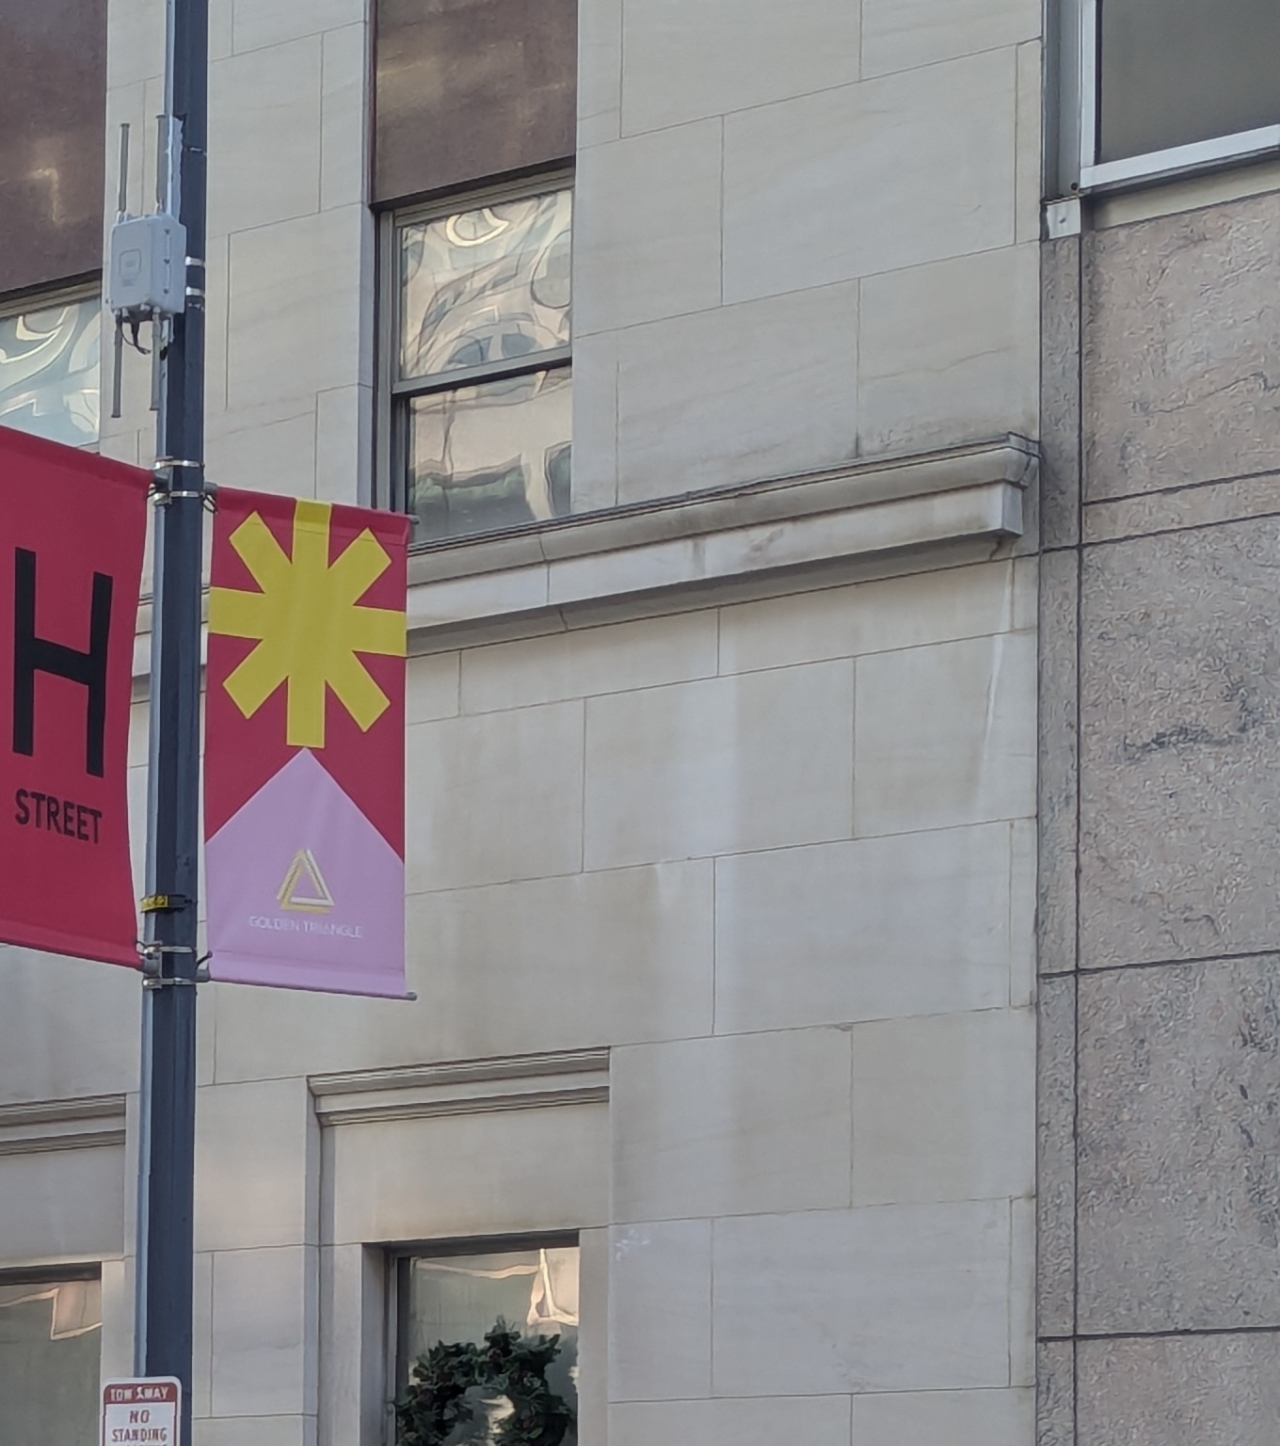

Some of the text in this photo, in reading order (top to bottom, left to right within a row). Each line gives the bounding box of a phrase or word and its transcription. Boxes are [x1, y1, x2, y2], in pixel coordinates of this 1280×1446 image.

[13, 547, 113, 777] H
[15, 788, 102, 844] STREET
[248, 915, 300, 932] GOLDEN
[110, 1388, 132, 1401] TOW
[129, 1409, 150, 1424] NO
[111, 1428, 168, 1442] STANDING
